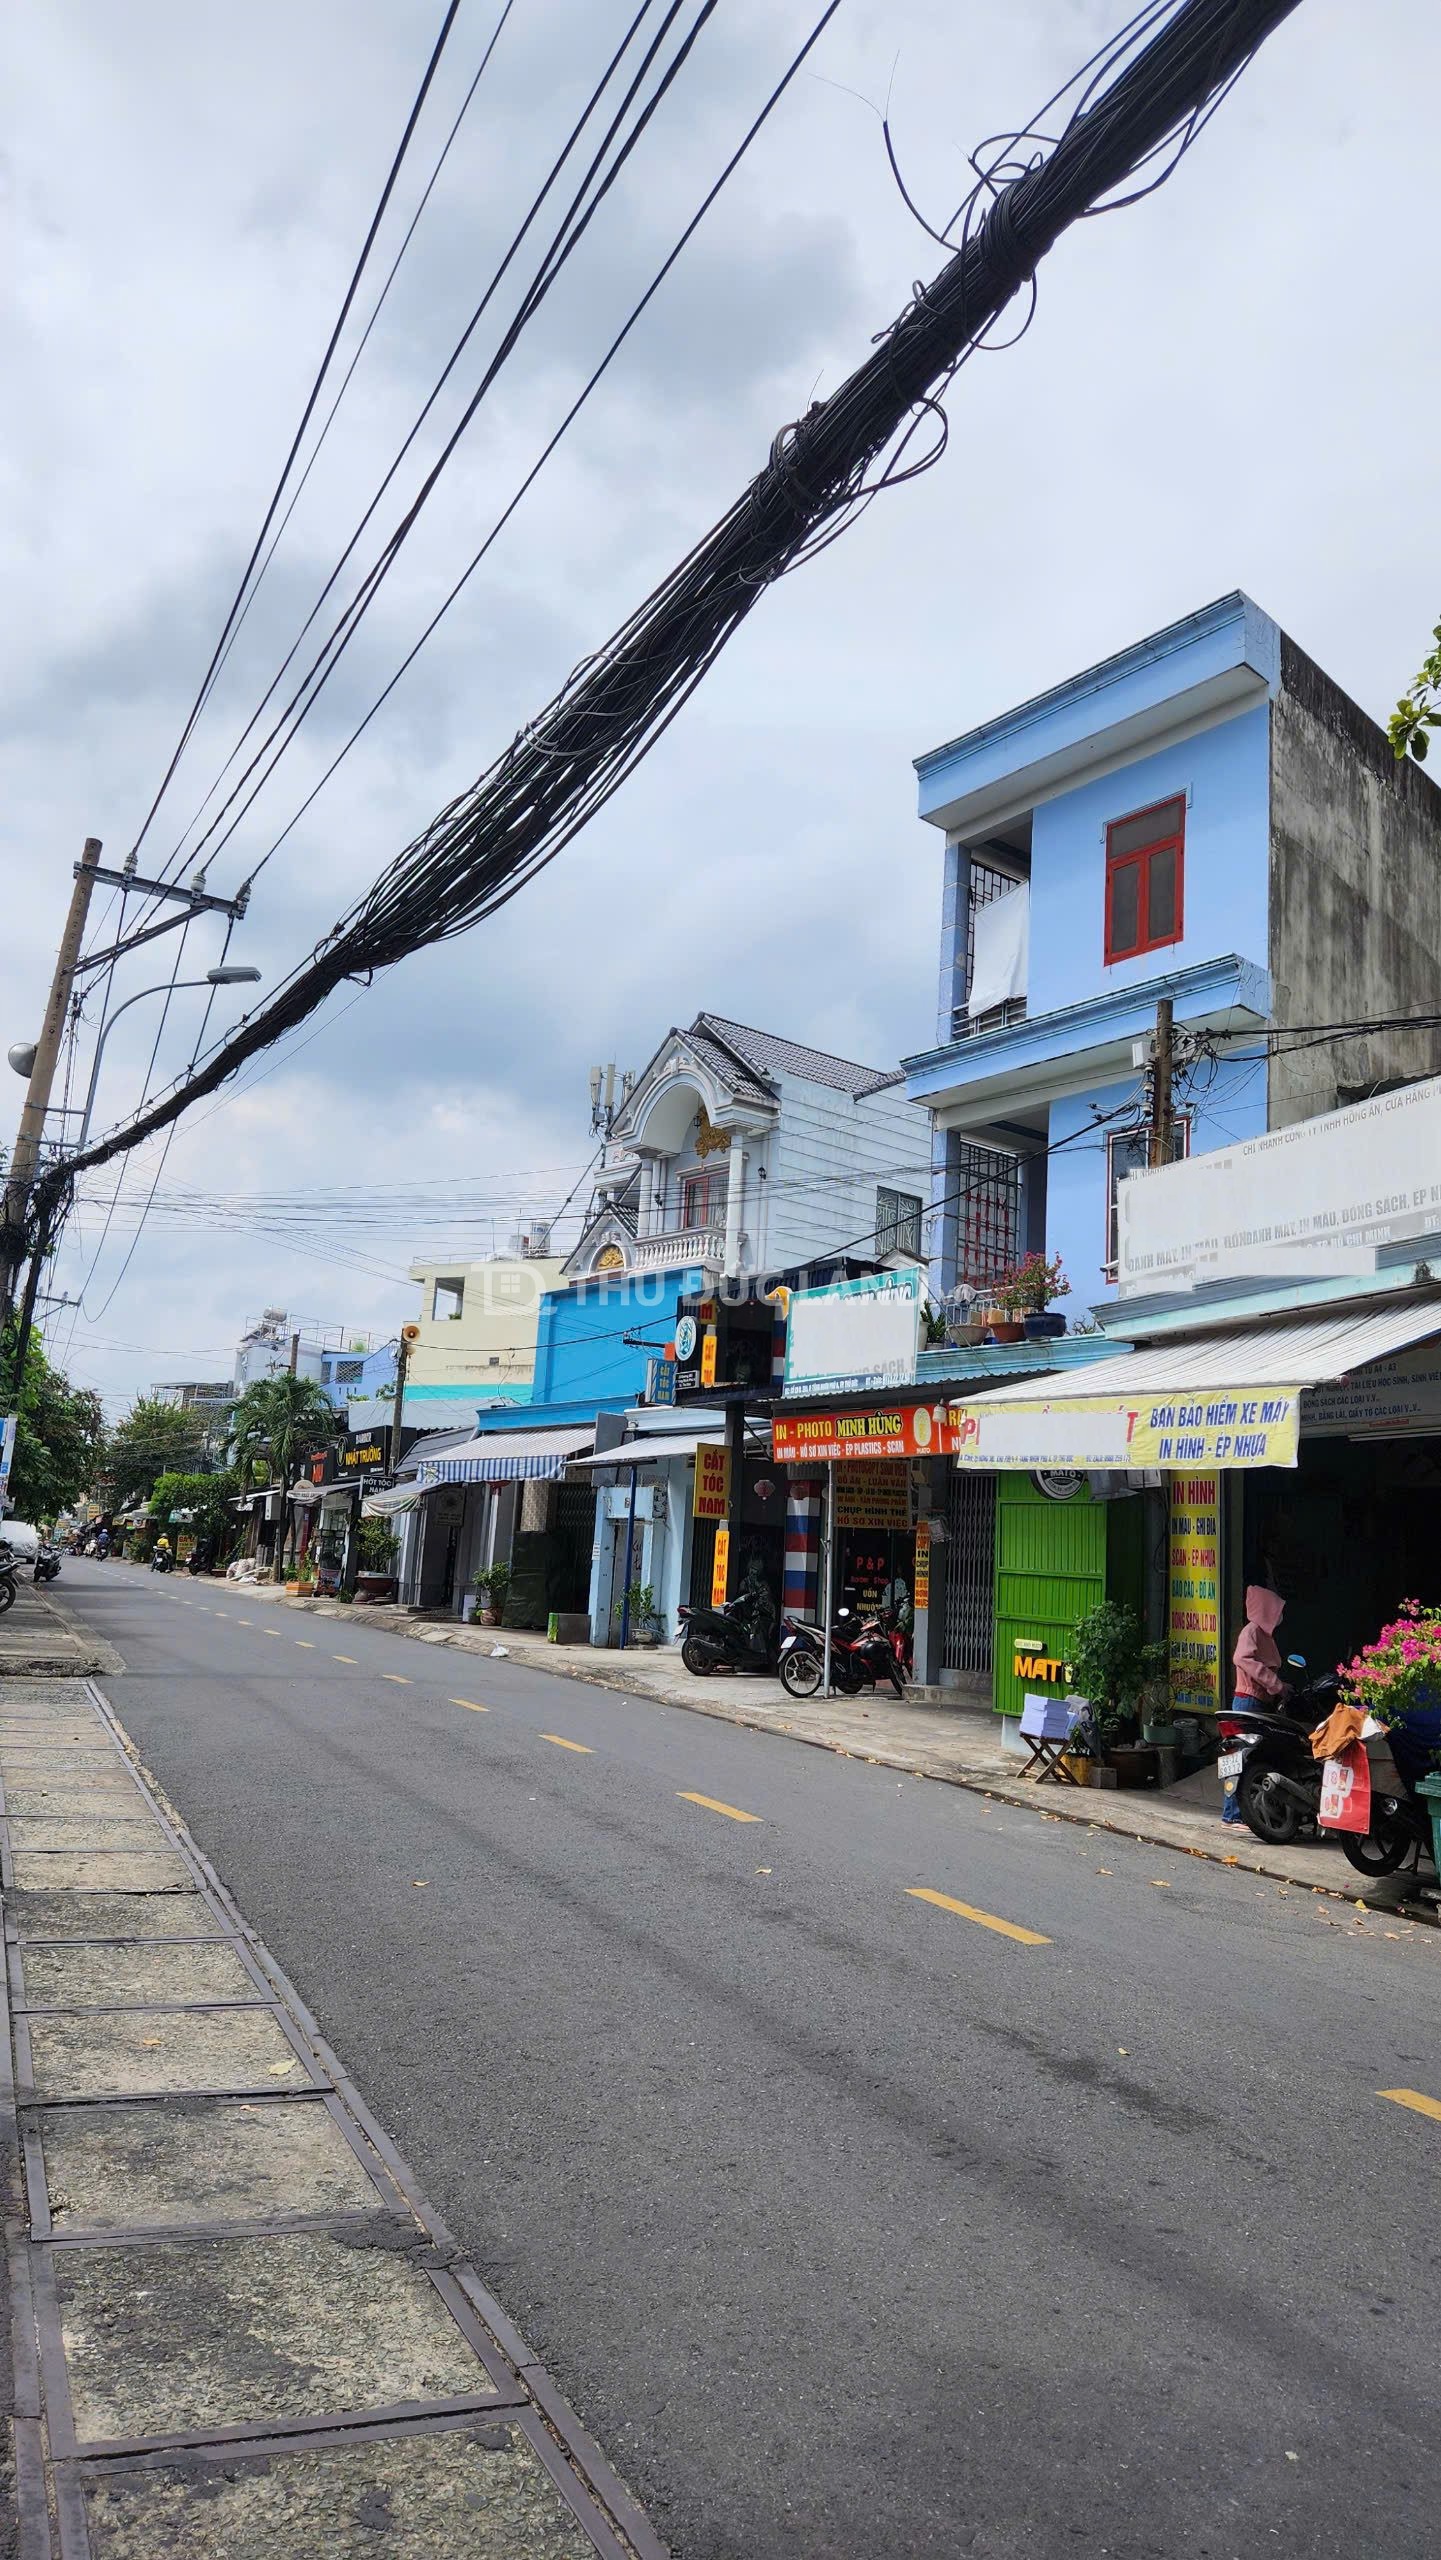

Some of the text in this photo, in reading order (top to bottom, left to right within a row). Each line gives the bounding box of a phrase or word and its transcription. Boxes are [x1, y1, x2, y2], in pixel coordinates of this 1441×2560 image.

[1179, 1398, 1203, 1427] BẢO
[1206, 1395, 1238, 1426] HIỂM
[1240, 1402, 1258, 1425] XE
[1260, 1396, 1290, 1424] MÁY
[775, 1424, 788, 1440] IN
[797, 1420, 832, 1439] PHOTO
[837, 1418, 866, 1438] MINH
[867, 1411, 902, 1436] HÙNG
[854, 1441, 882, 1456] PLASTICS
[887, 1440, 904, 1454] SCAN
[1159, 1438, 1173, 1459] IN
[1176, 1433, 1205, 1459] HÌNH
[1215, 1432, 1231, 1458] ÉP
[1233, 1432, 1267, 1461] NHỰA
[704, 1449, 725, 1471] CẮT
[703, 1473, 724, 1493] TÓC
[1173, 1476, 1216, 1505] IN HÌNH
[698, 1496, 725, 1515] NAM
[837, 1505, 862, 1515] CHỤP
[864, 1506, 887, 1515] HÌNH
[868, 1518, 884, 1526] XIN
[887, 1518, 908, 1529] VIỆC
[856, 1556, 886, 1571] P & P
[917, 1550, 929, 1558] IN
[1172, 1548, 1187, 1567] SCAN
